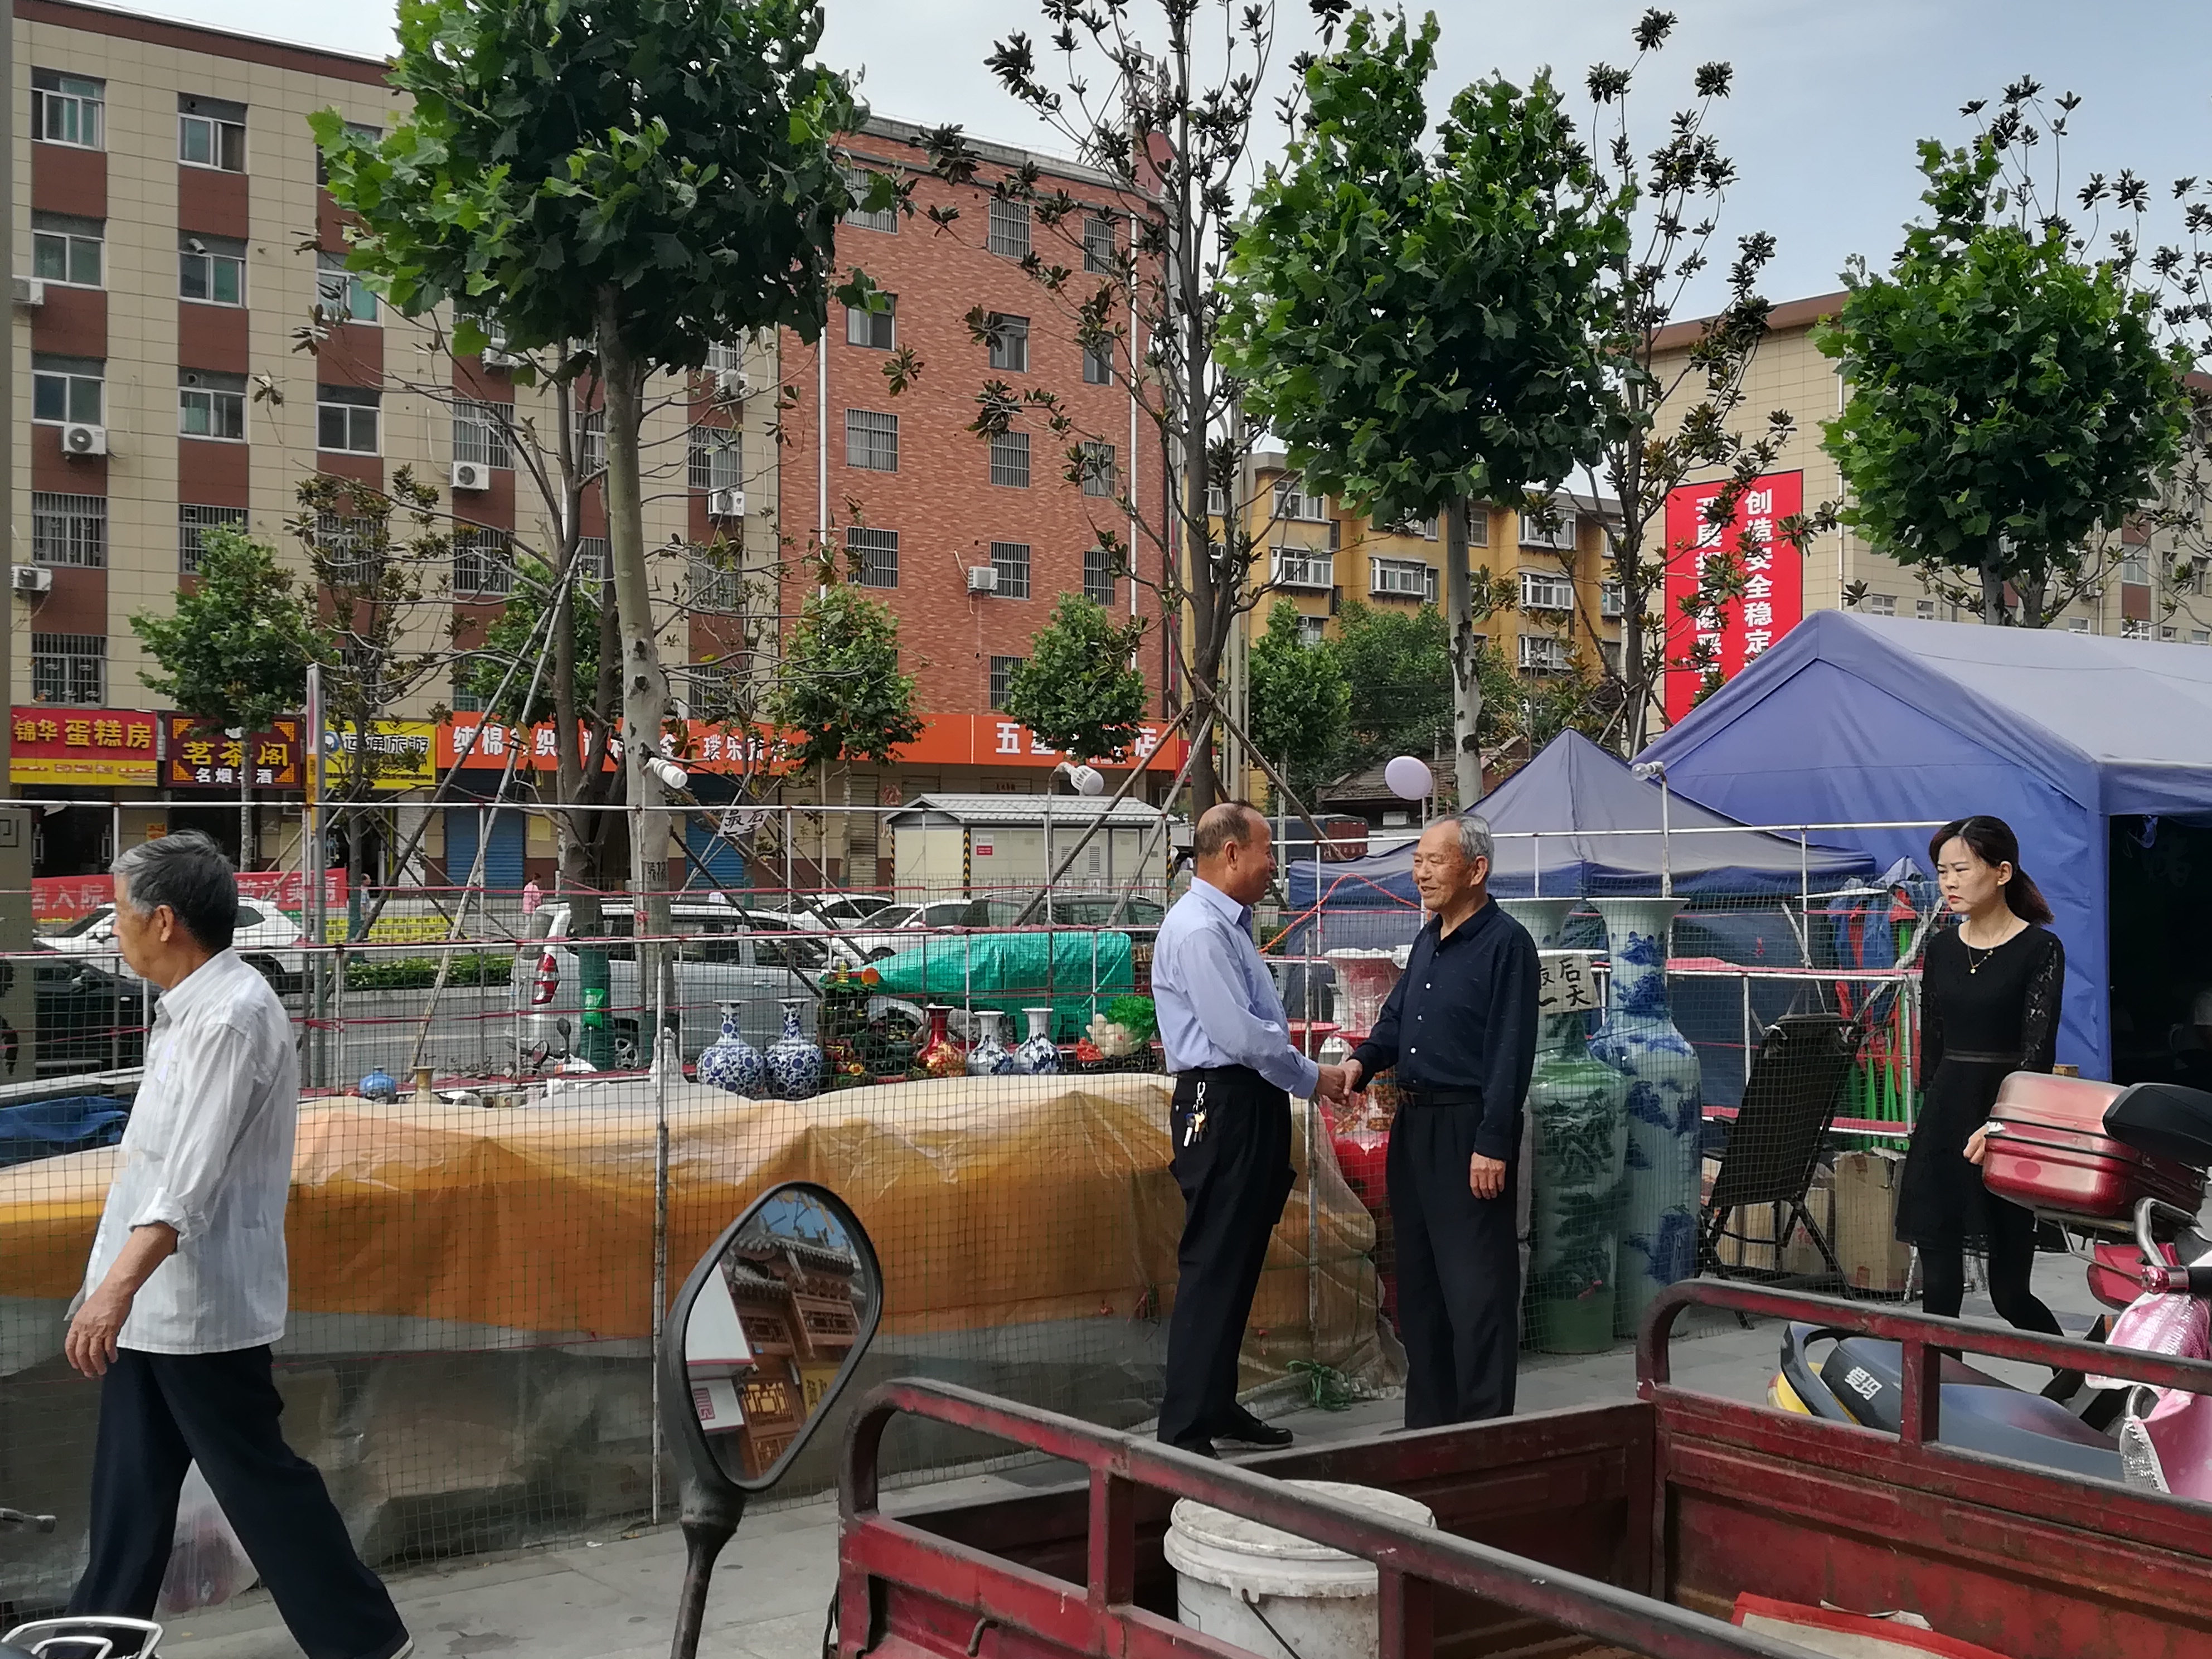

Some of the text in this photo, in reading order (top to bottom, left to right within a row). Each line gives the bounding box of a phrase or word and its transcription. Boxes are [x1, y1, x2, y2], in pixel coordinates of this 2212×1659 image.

[14, 719, 153, 749] 锦华蛋糕房
[196, 767, 273, 784] 名烟酒
[1844, 1366, 1883, 1400] 爱玛
